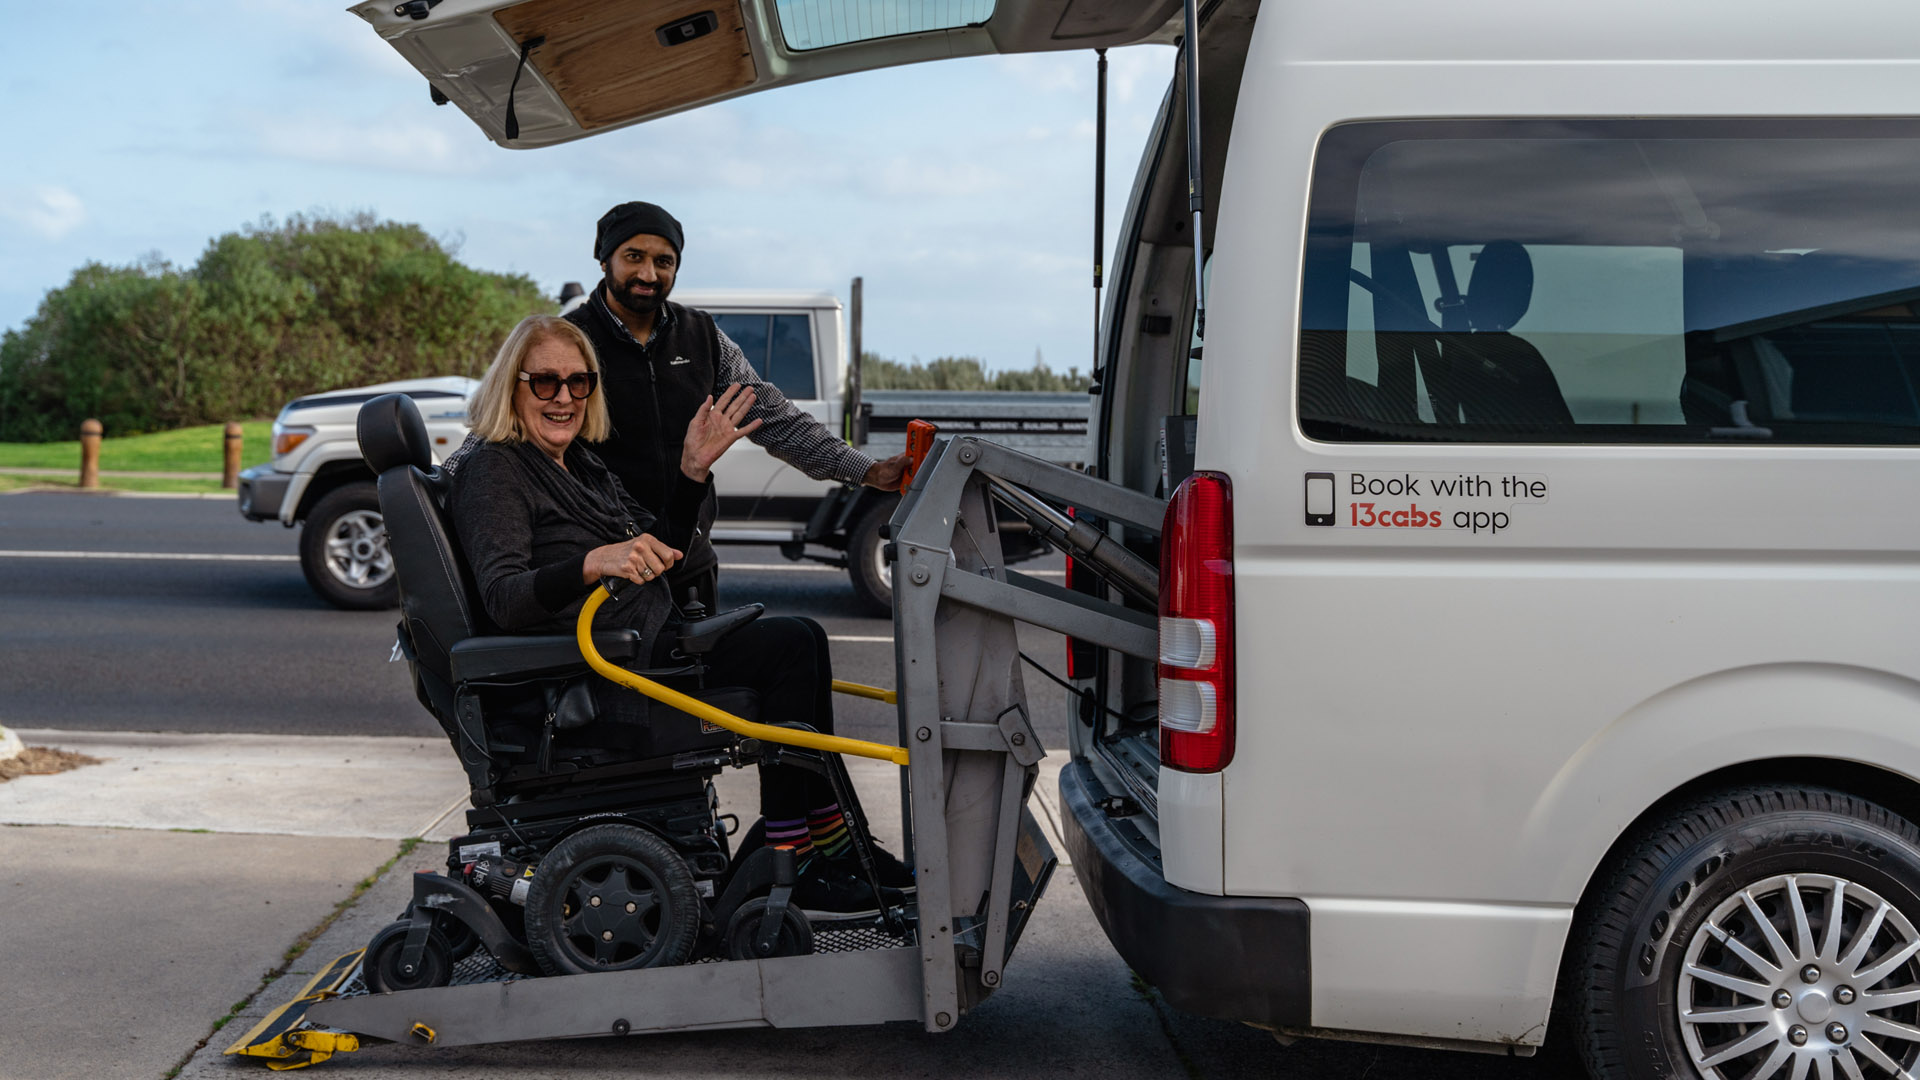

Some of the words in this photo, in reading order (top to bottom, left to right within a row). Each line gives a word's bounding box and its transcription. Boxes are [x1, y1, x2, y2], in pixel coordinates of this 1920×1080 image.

[979, 421, 1019, 431] DOMESTIC
[1022, 421, 1059, 431] BUILDING
[1350, 473, 1421, 496] Book
[1430, 475, 1492, 498] with
[1501, 475, 1547, 498] the
[1350, 502, 1442, 528] 13cabs
[1453, 510, 1509, 534] app
